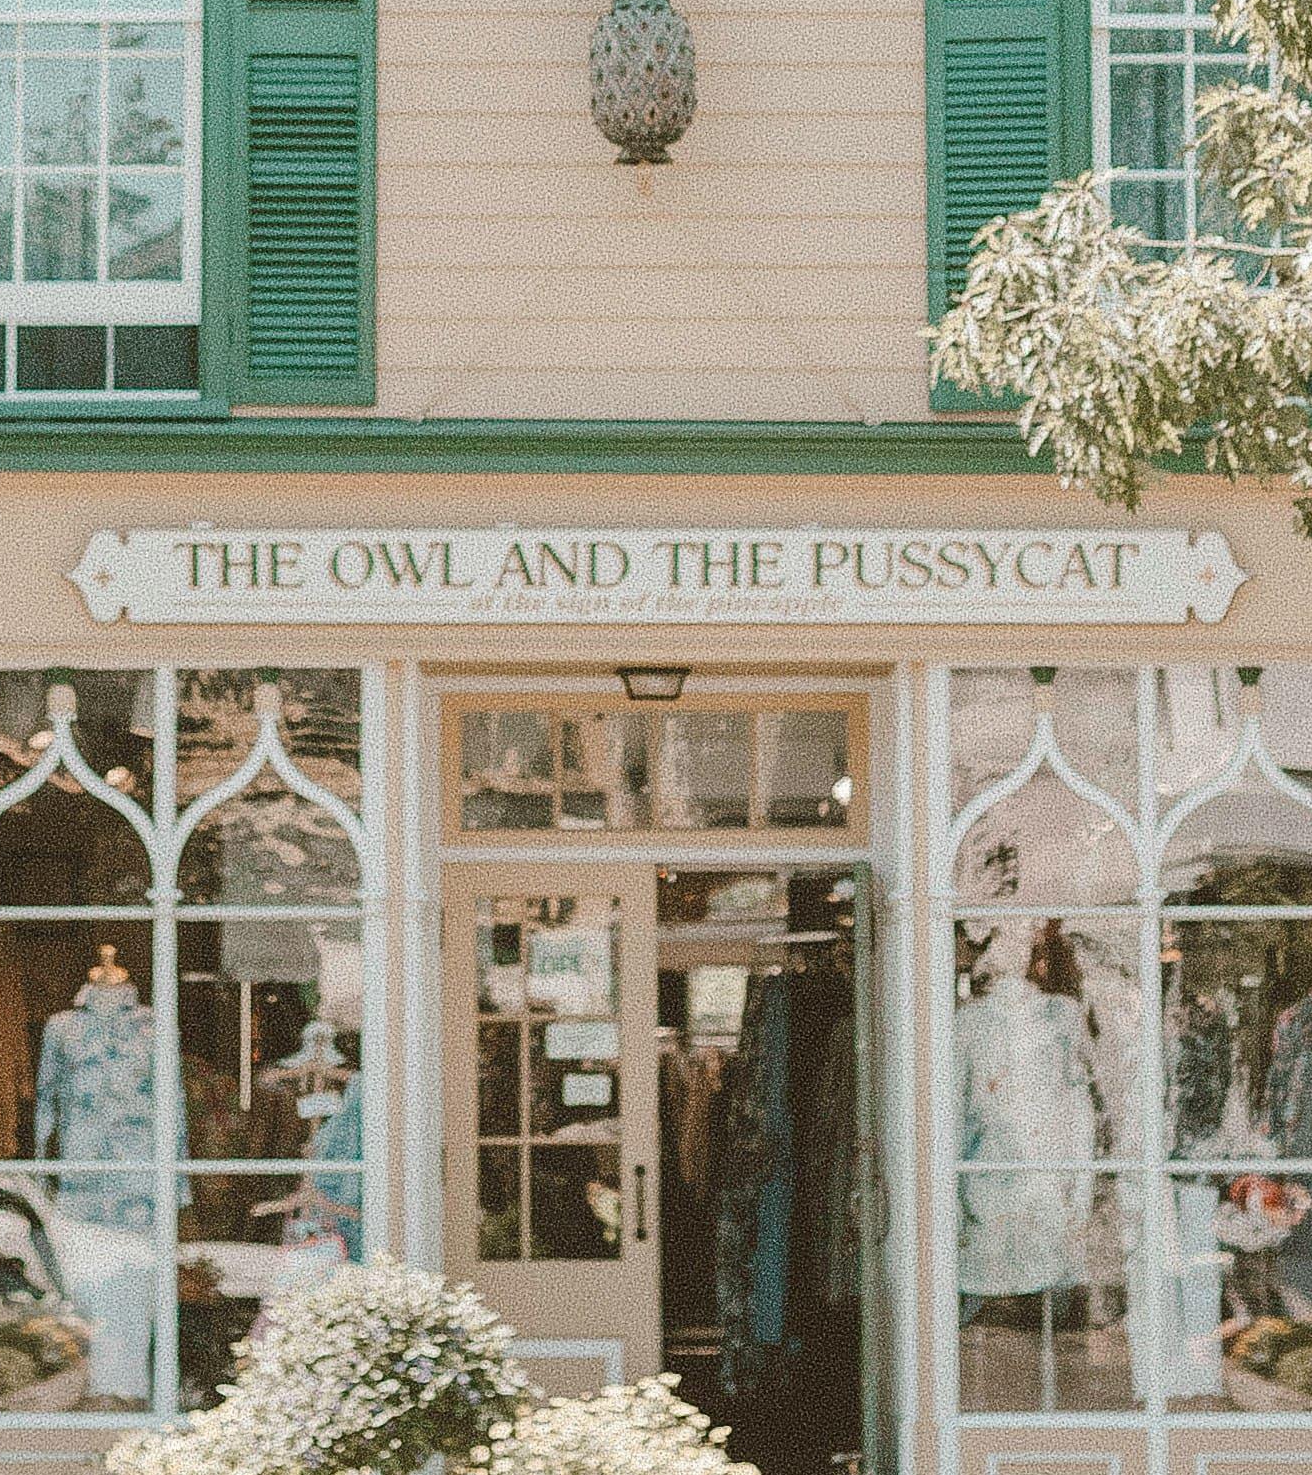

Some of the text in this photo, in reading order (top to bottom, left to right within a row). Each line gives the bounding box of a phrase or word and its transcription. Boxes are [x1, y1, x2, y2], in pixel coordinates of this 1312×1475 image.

[174, 541, 1141, 590] THE OWL AND THE PUSSYCAT
